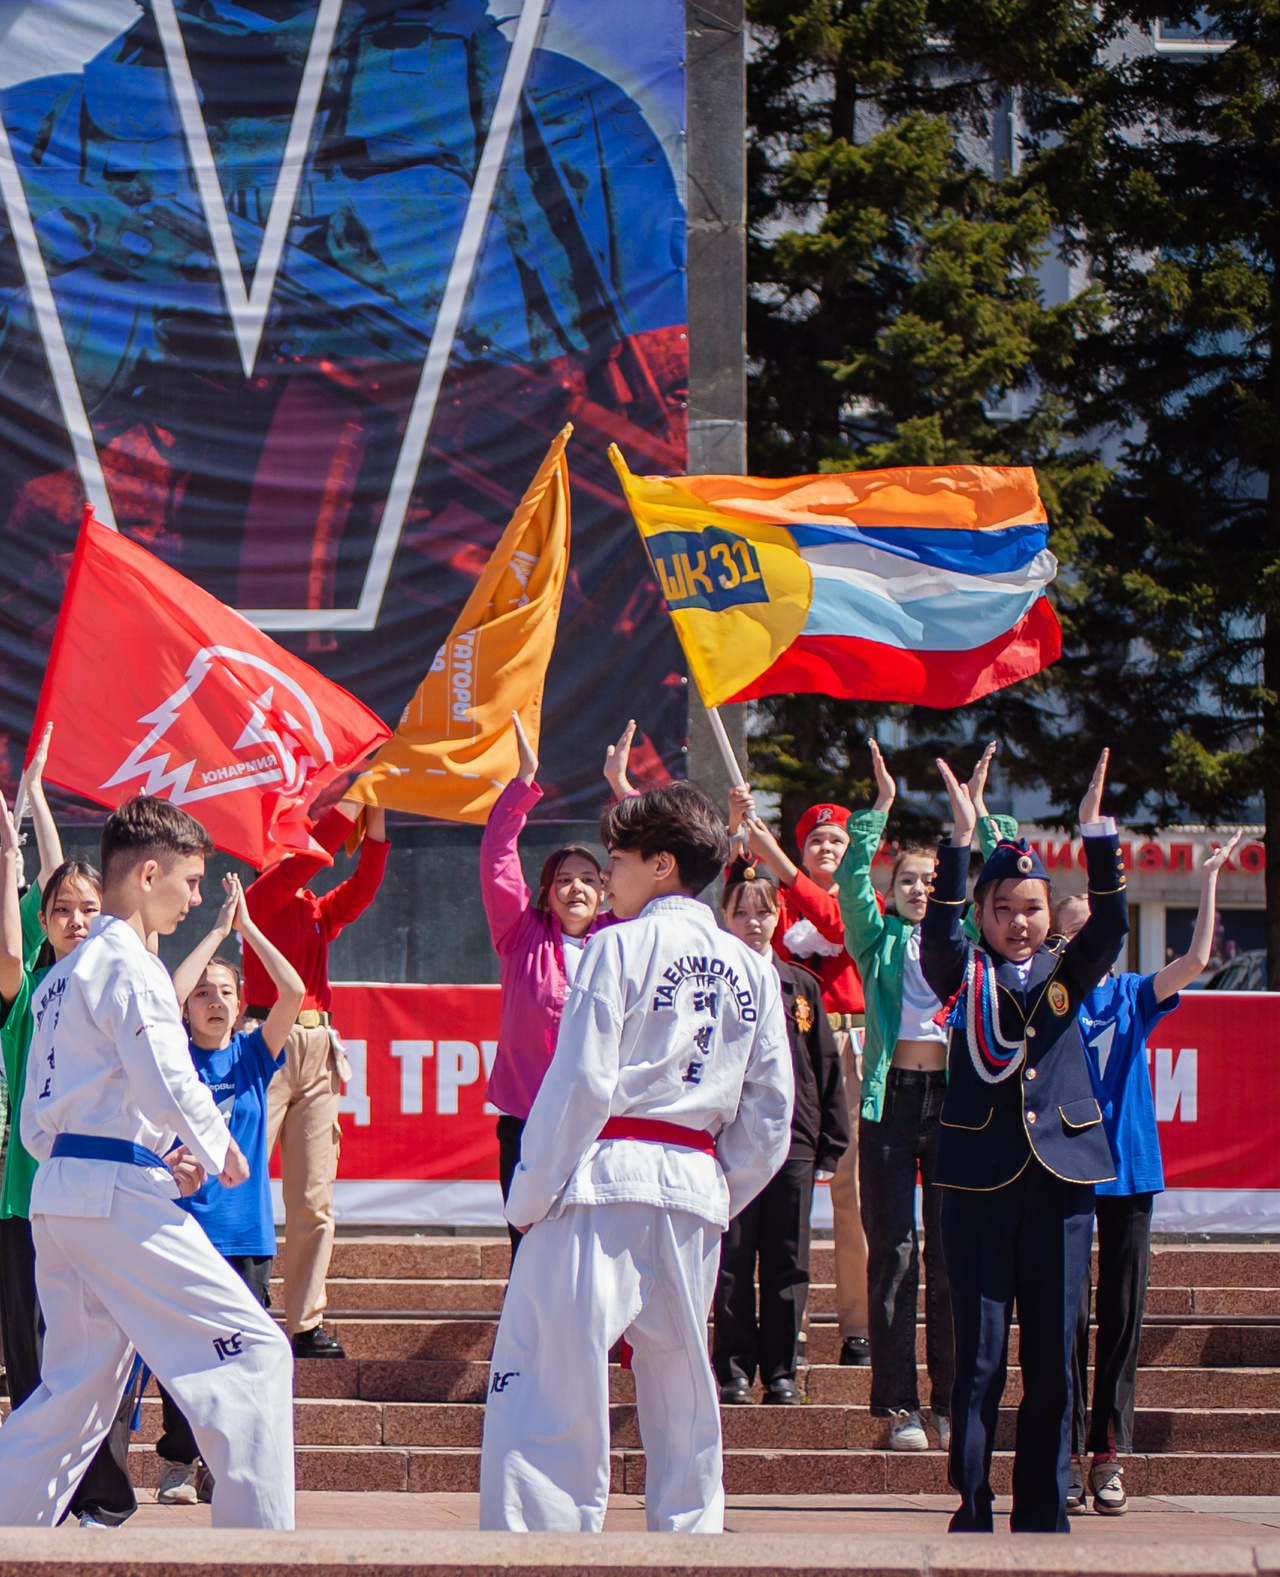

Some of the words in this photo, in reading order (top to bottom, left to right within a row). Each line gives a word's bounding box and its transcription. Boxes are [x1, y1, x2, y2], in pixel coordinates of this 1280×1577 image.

[709, 540, 761, 590] 31
[201, 753, 278, 784] ЮНАРМИЯ
[653, 955, 757, 1022] TAEKWON-DO
